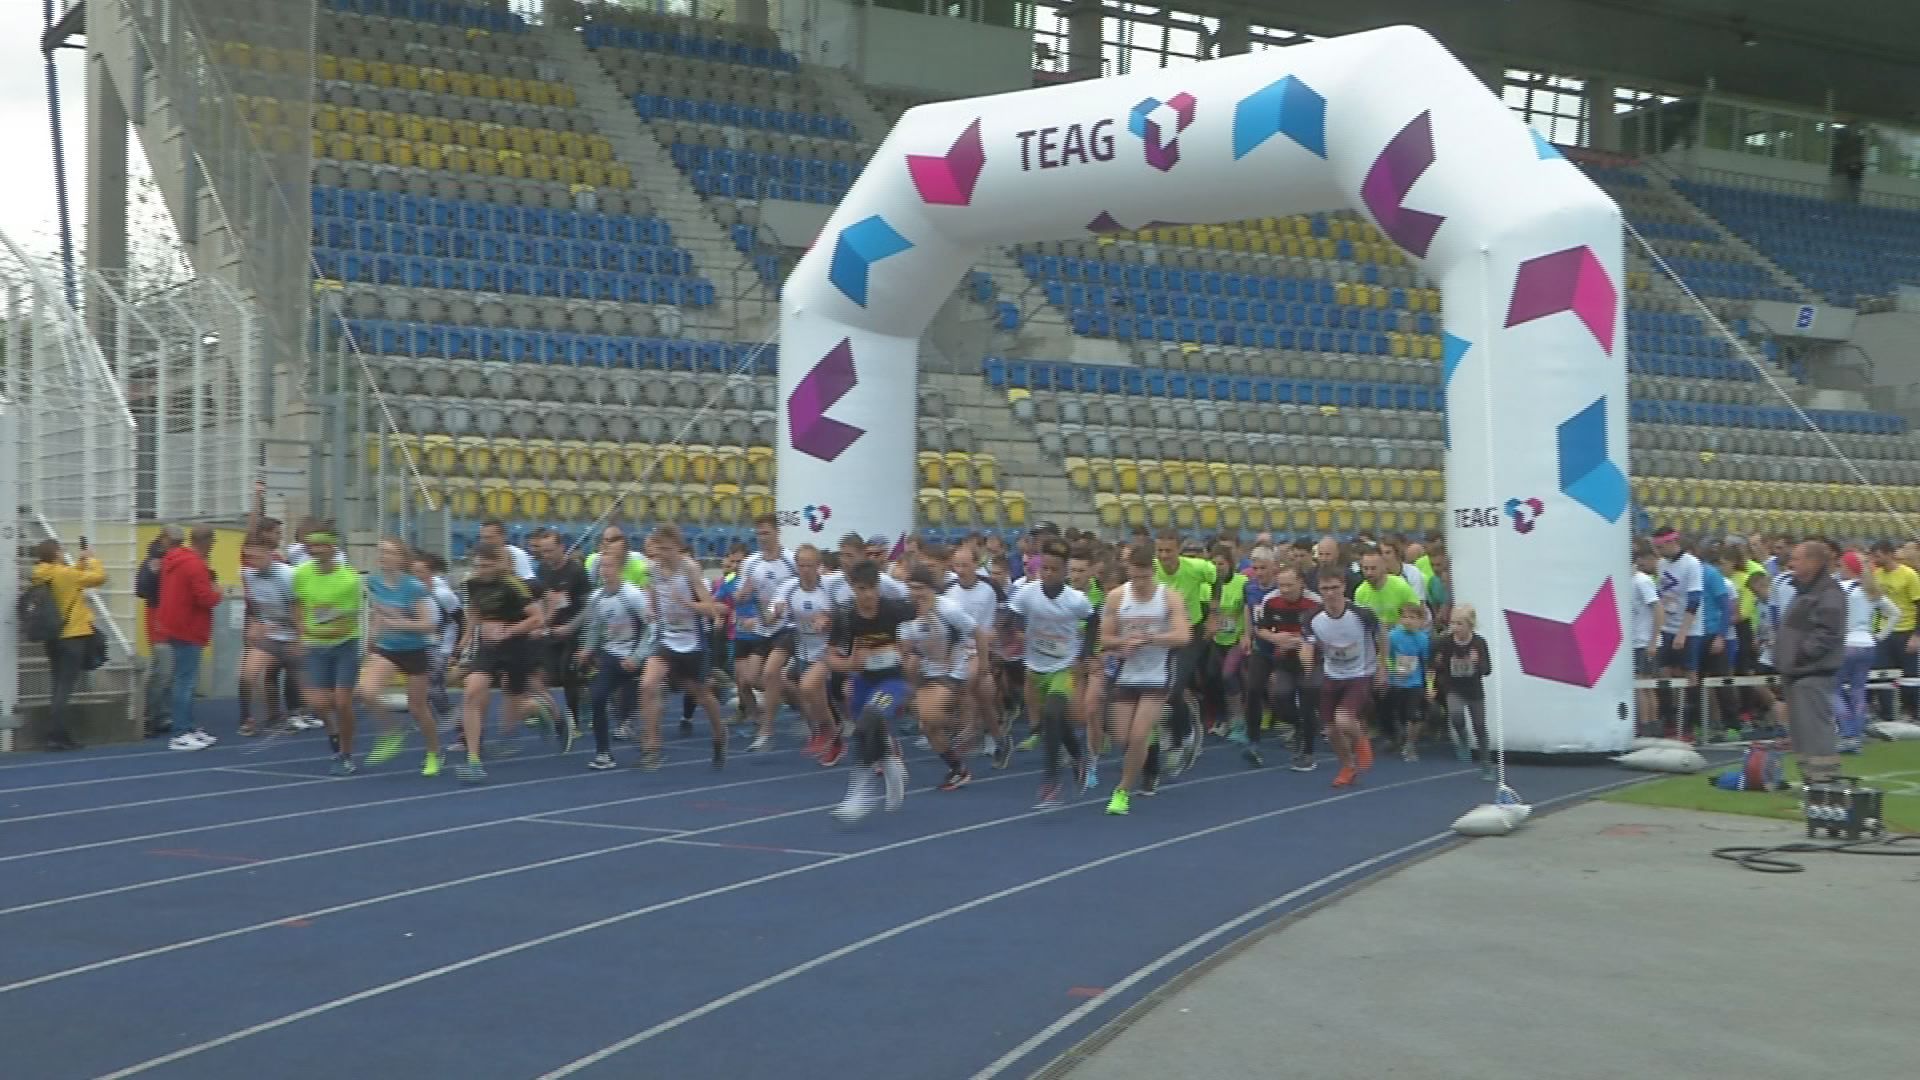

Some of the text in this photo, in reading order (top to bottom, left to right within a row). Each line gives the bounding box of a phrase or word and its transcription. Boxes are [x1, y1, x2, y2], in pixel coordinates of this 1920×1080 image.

[1016, 118, 1116, 171] TEAG
[1796, 307, 1814, 328] B
[1454, 507, 1500, 528] TEAG
